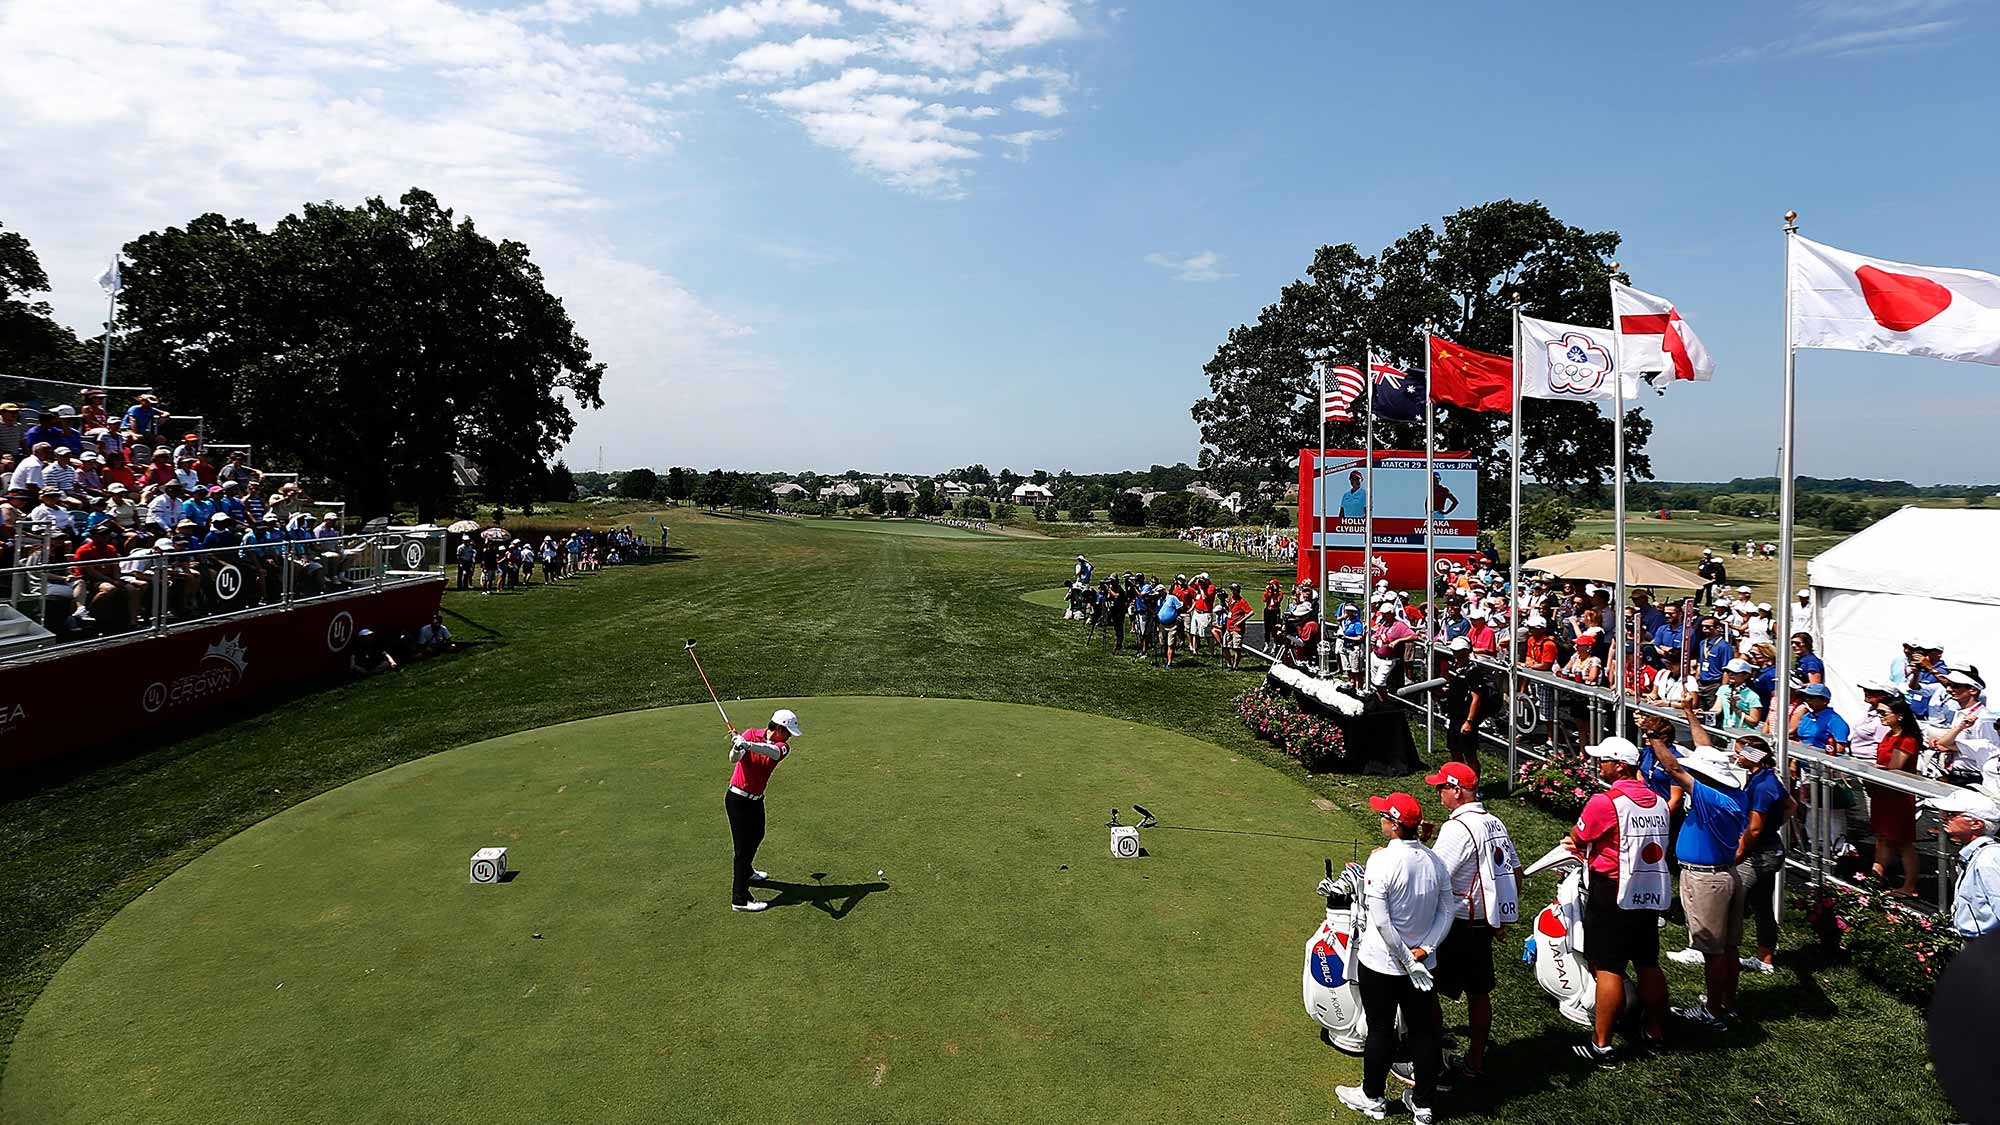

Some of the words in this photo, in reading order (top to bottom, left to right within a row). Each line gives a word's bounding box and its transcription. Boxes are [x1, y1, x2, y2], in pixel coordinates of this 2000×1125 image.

[1381, 461, 1410, 469] MATCH
[1456, 462, 1472, 470] JPN
[1341, 517, 1366, 525] HOLLY
[1423, 519, 1450, 527] AAKA
[1414, 527, 1460, 535] WAANABE
[1393, 536, 1408, 544] AM
[170, 671, 232, 700] CROWN
[1631, 815, 1667, 829] NOMURA
[1632, 892, 1661, 905] #JPN
[1548, 939, 1572, 990] JAPAN
[1316, 945, 1333, 984] REPUBLIC
[1330, 997, 1345, 1022] KOREA
